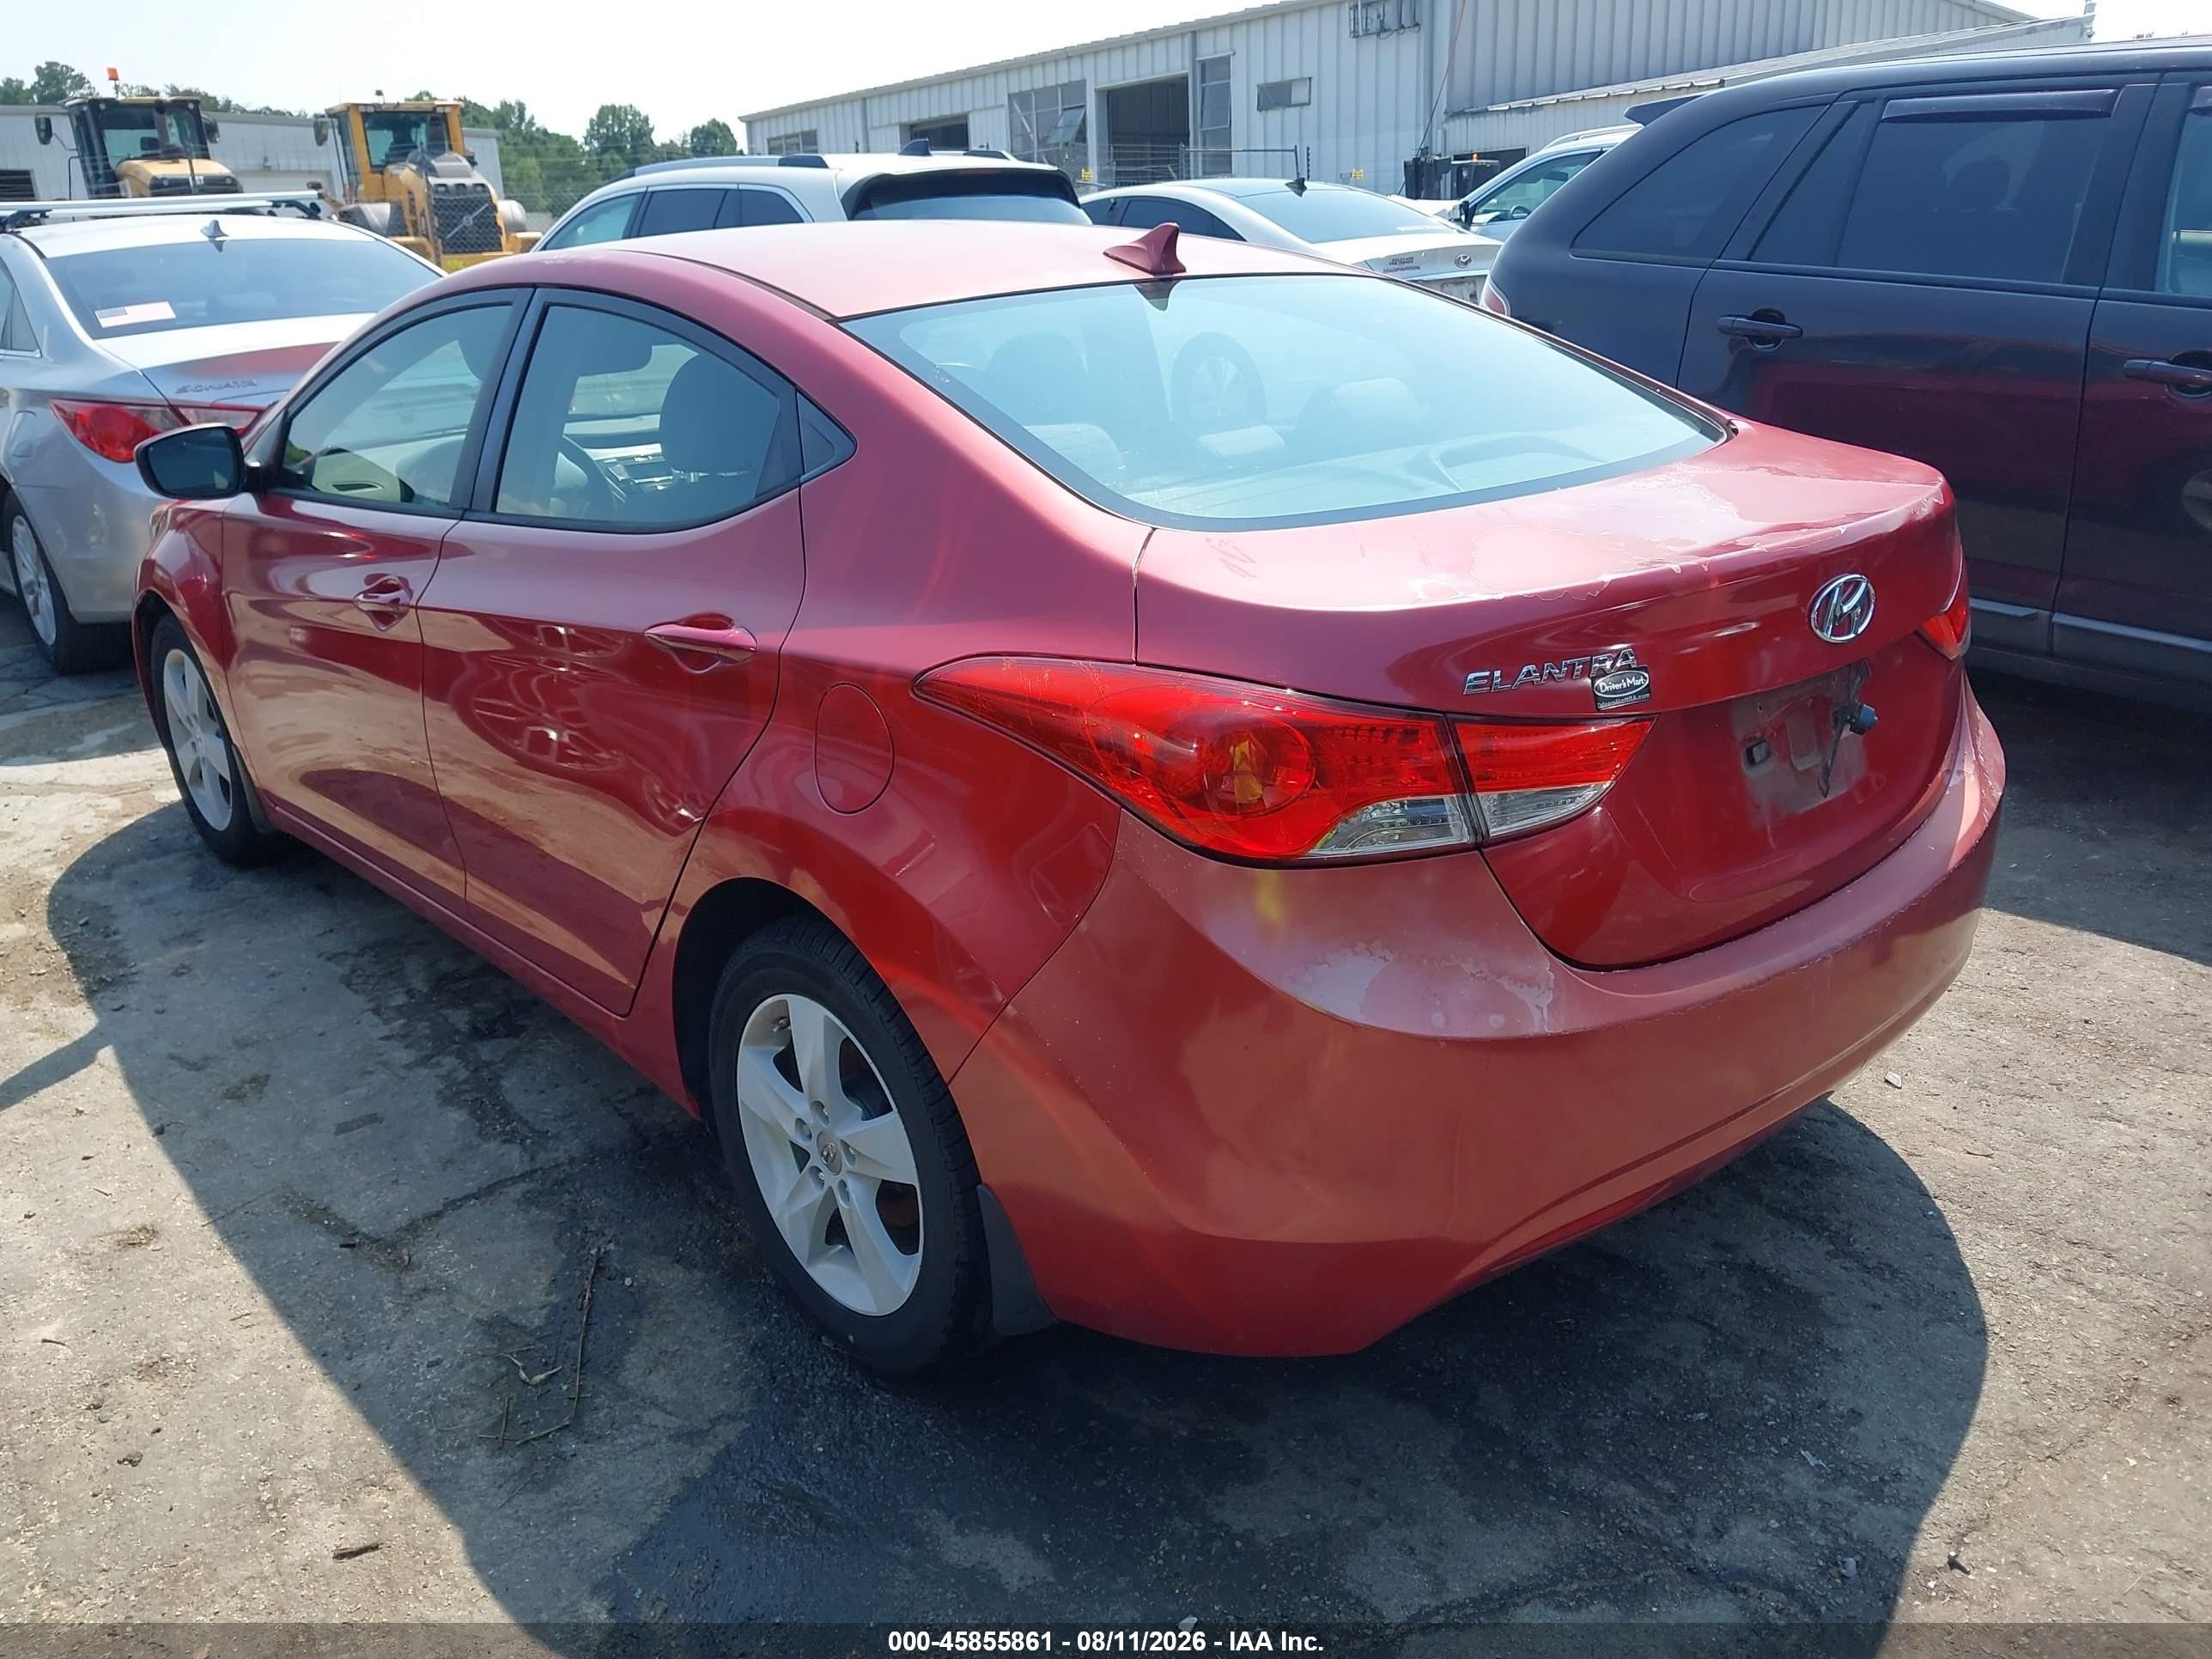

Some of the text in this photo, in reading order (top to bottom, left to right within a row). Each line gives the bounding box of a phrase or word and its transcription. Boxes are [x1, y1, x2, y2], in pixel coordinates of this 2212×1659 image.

[1462, 648, 1637, 695] ELANTRA
[1599, 676, 1644, 693] Driver's Mart
